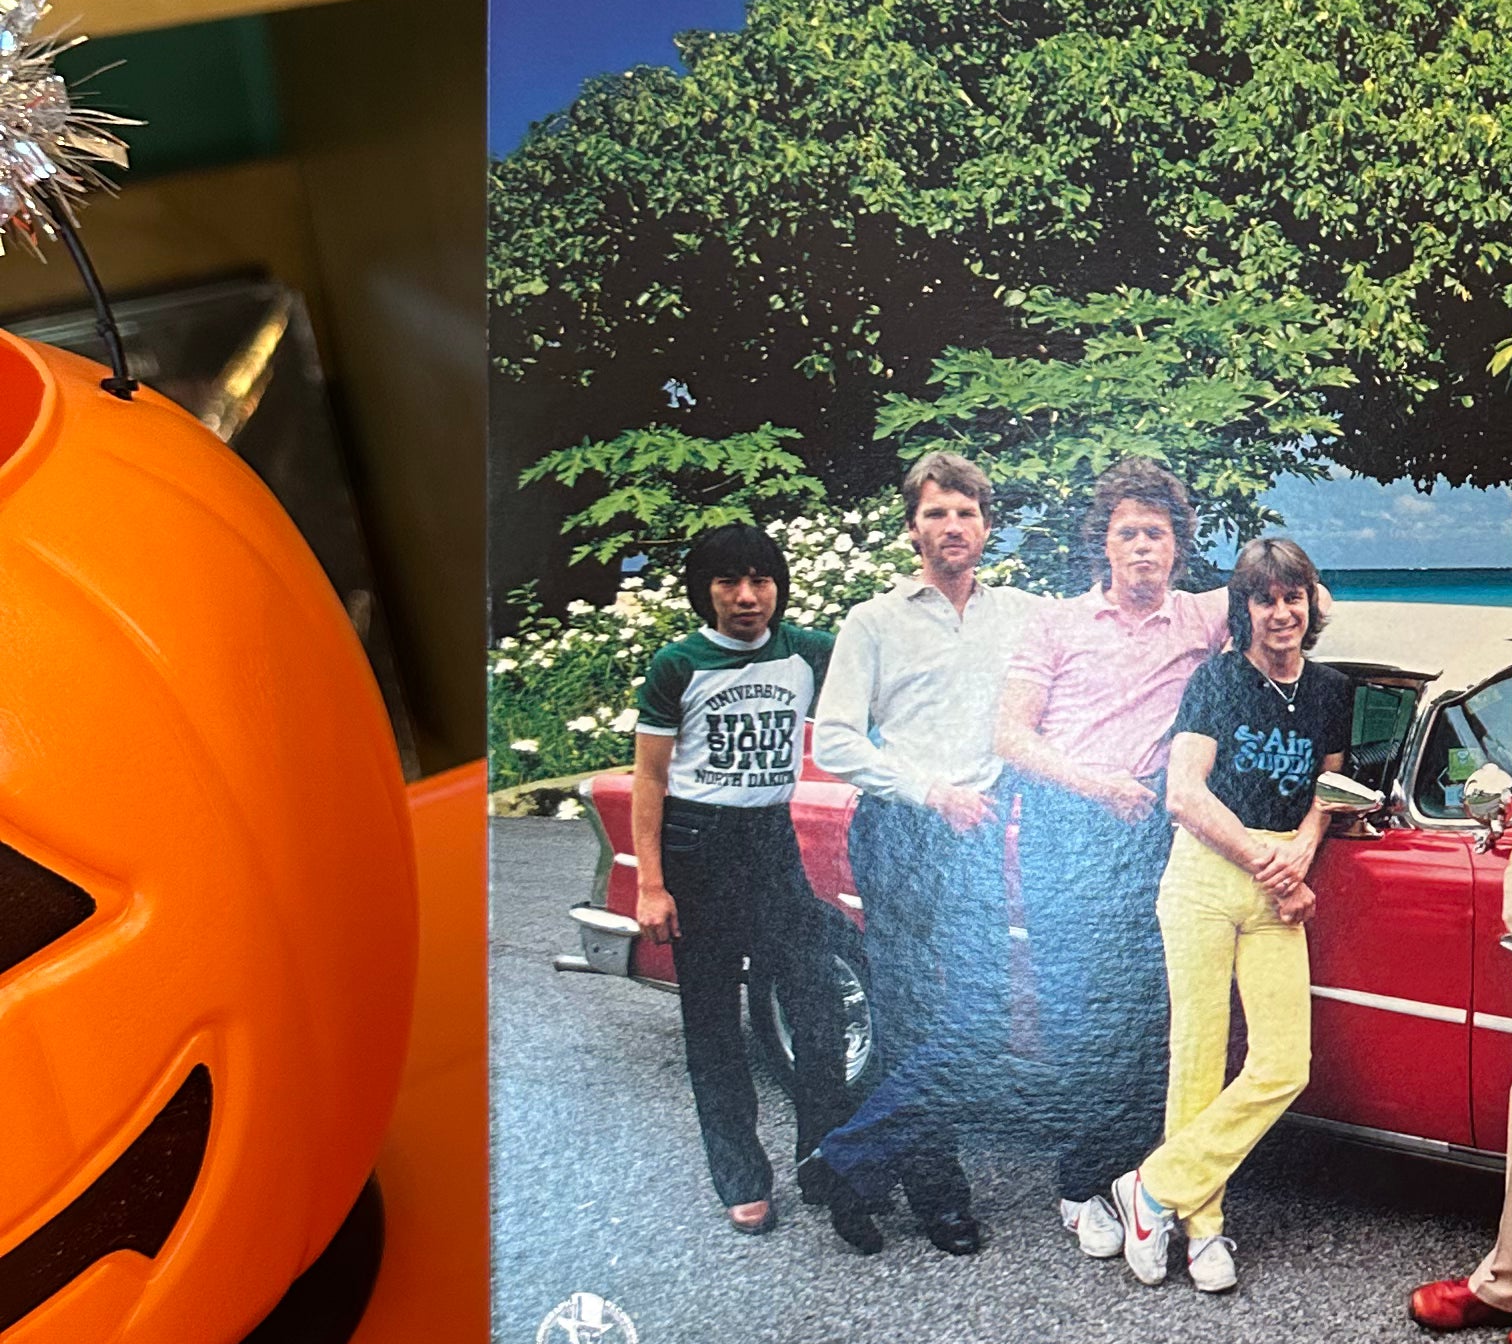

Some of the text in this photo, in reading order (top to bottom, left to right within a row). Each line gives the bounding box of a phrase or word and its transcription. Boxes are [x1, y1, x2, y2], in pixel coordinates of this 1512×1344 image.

[705, 684, 796, 711] UNIVERSITY
[707, 730, 794, 752] SIOUX
[1262, 726, 1313, 756] Air
